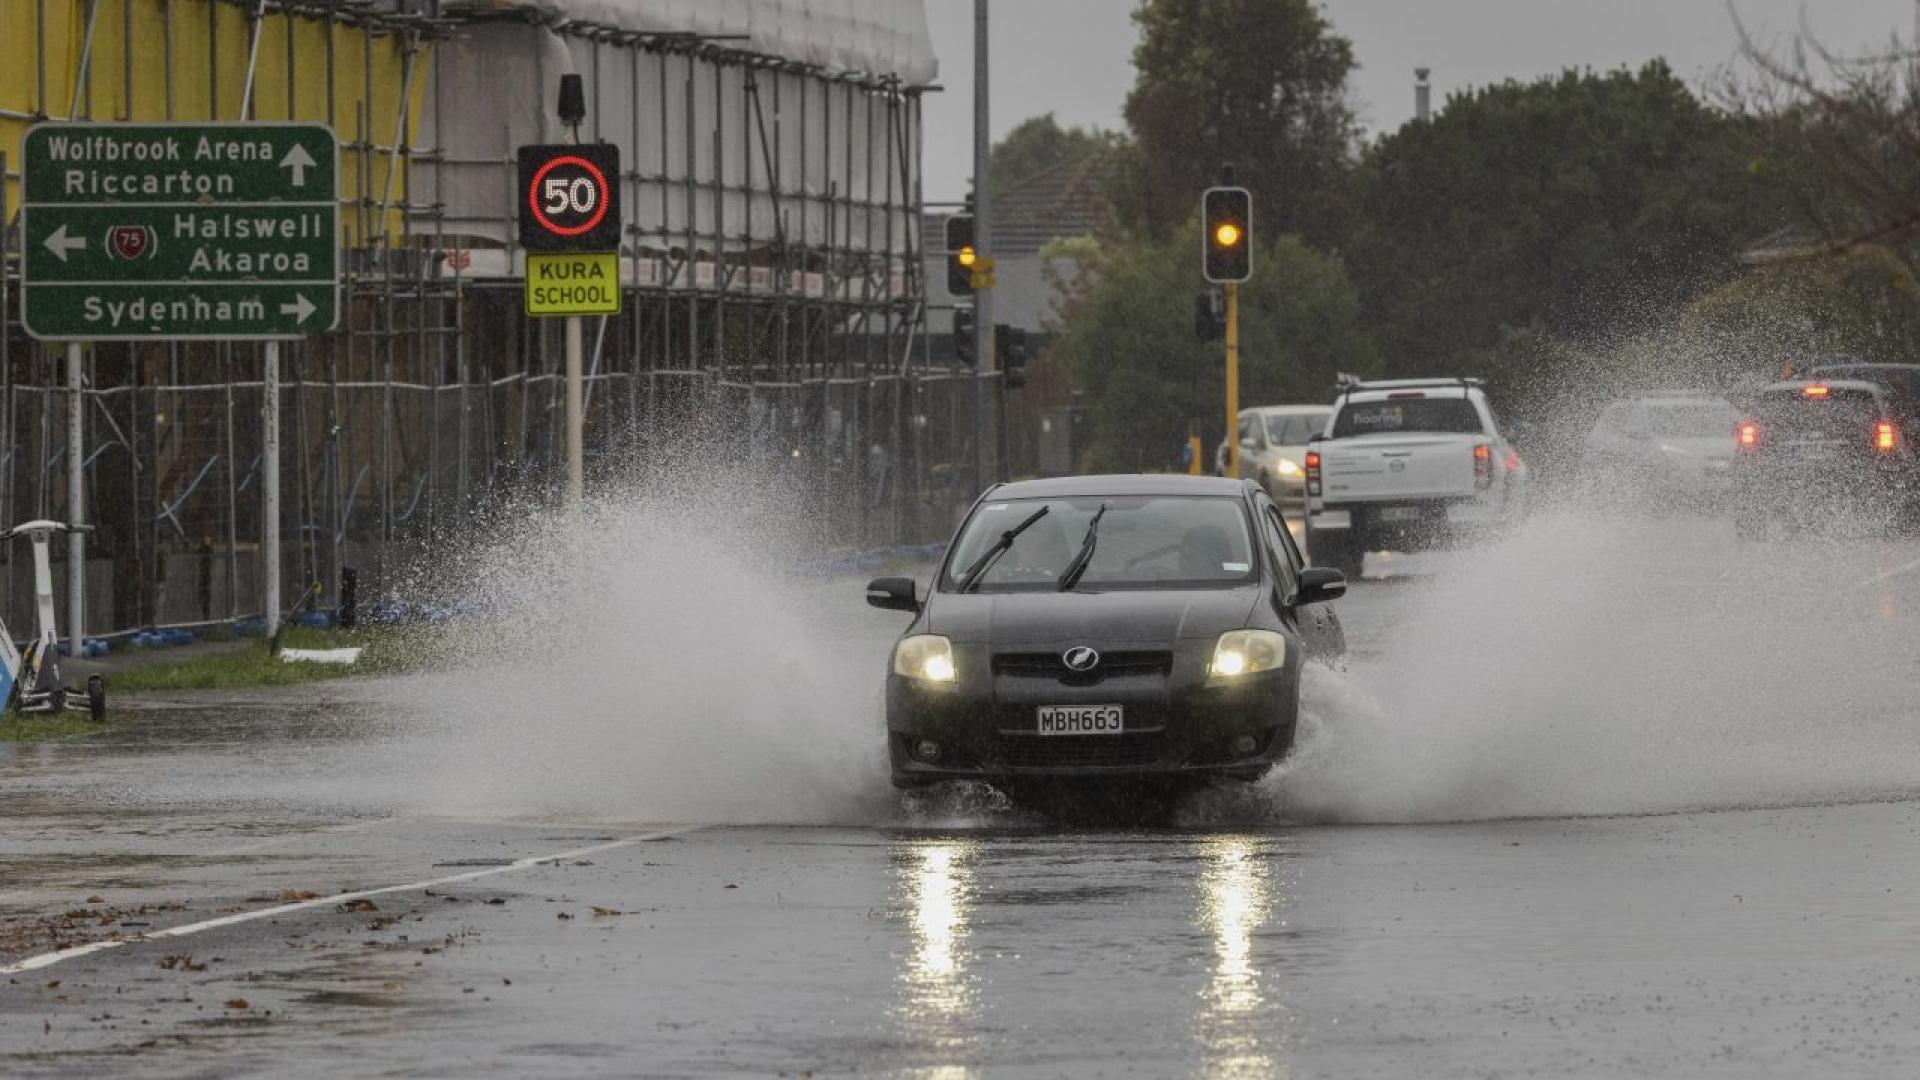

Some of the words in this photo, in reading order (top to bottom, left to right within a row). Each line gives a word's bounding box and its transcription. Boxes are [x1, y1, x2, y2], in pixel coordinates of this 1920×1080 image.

[49, 136, 179, 161] Wolfbrook
[194, 136, 274, 161] Arena
[65, 169, 234, 194] Riccarton
[545, 177, 596, 214] 50
[174, 213, 321, 238] Halswell
[120, 232, 140, 247] 75
[189, 248, 310, 272] Akaroa
[540, 262, 604, 280] KURA
[534, 286, 612, 305] SCHOOL
[83, 296, 265, 327] Sydenham
[1041, 710, 1120, 731] MBH663
